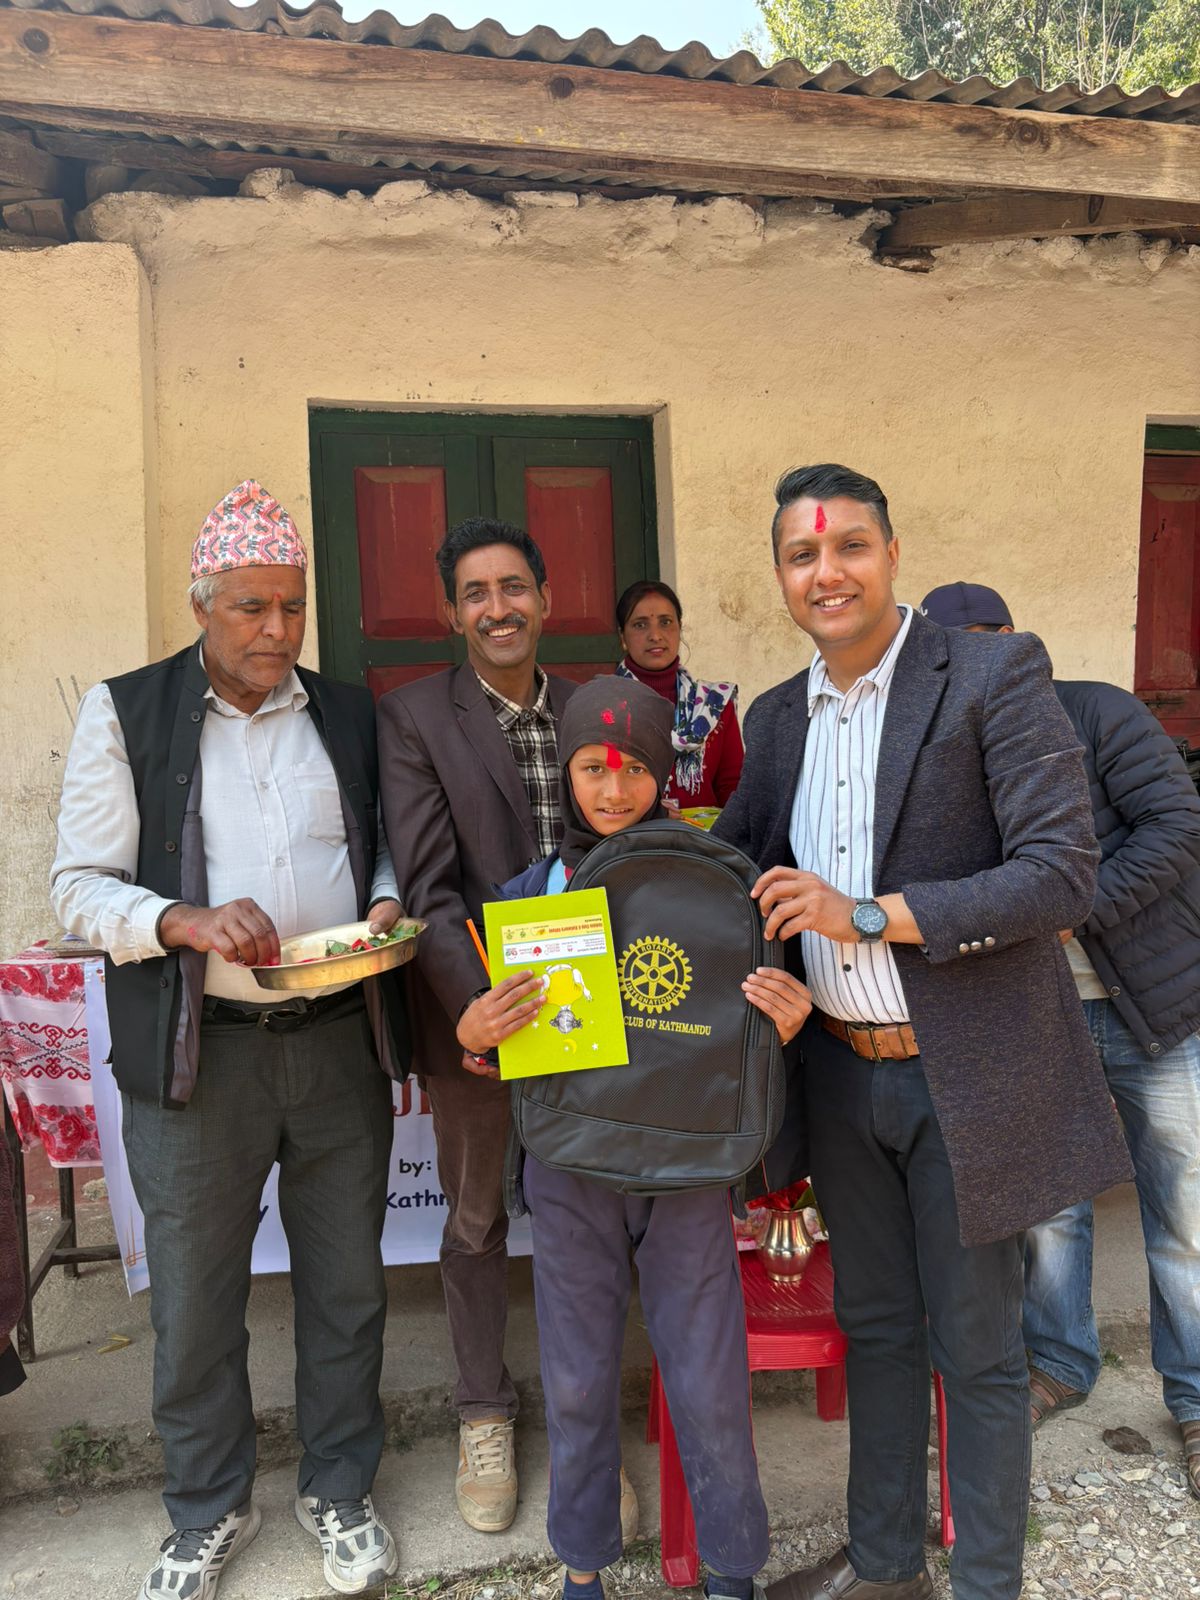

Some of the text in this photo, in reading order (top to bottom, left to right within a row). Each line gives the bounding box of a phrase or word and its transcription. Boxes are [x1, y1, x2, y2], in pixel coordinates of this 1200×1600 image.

[641, 944, 671, 954] ROTARY
[627, 982, 680, 1005] INTERNATIONAL
[624, 1016, 711, 1036] CLUB OF KATHMANDU
[399, 1158, 431, 1178] by:
